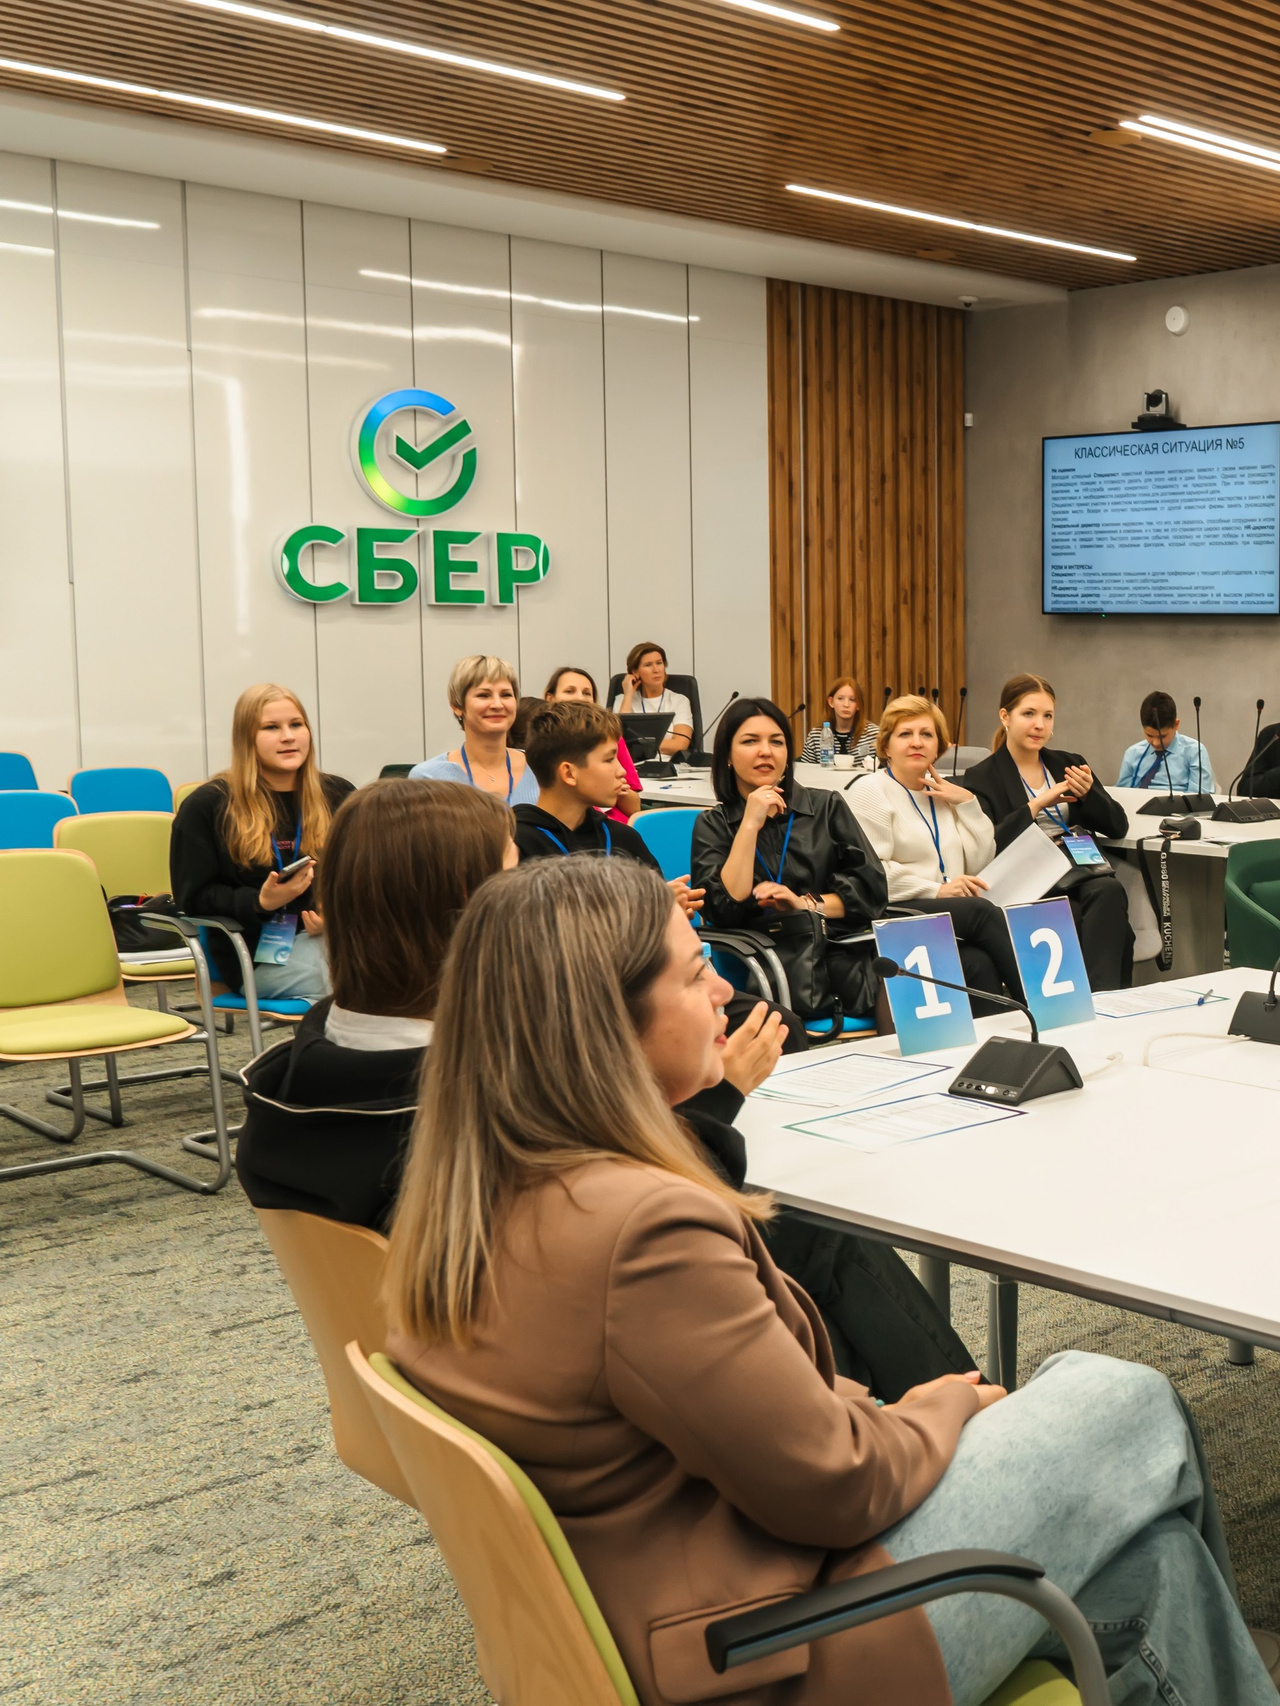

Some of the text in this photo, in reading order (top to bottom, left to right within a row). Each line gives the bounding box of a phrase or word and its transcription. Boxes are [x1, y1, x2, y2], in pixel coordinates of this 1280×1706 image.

[1074, 437, 1245, 459] КЛАССИЧЕСКАЯ СИТУАЦИЯ №5
[276, 523, 551, 606] СБЕР
[904, 945, 952, 1020] 1
[1029, 927, 1075, 998] 2
